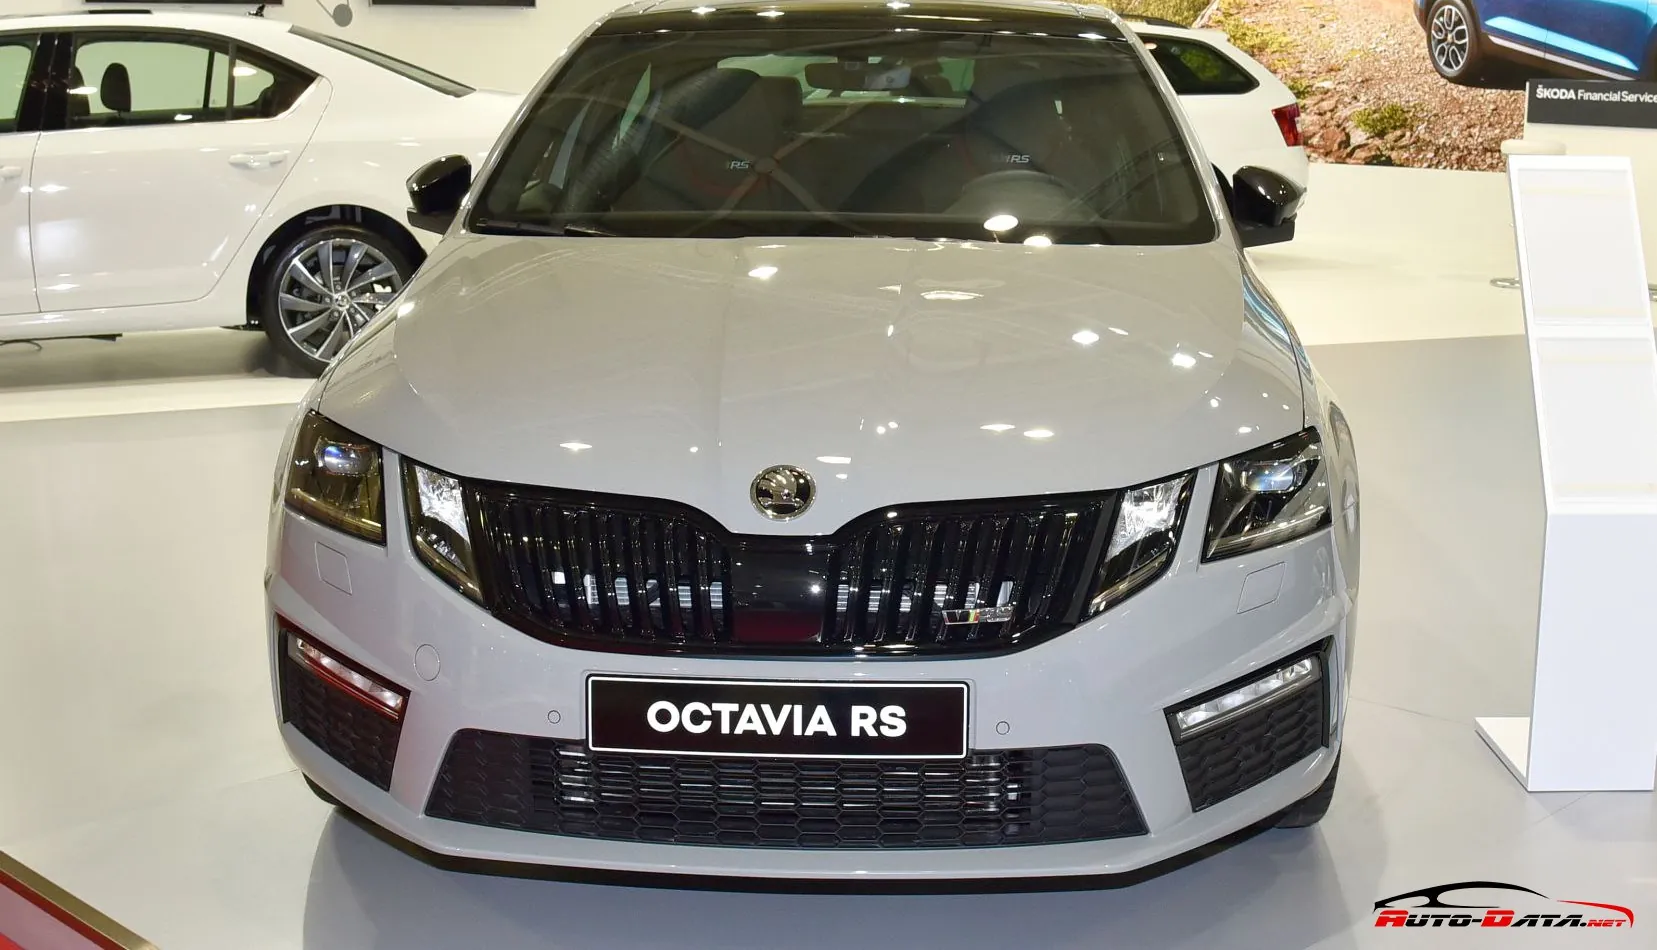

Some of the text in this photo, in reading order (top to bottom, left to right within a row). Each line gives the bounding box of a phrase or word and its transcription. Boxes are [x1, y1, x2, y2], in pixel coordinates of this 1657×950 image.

[1536, 84, 1576, 100] ŠKODA
[1578, 89, 1620, 102] Financial
[647, 700, 907, 738] OCTAVIA RS
